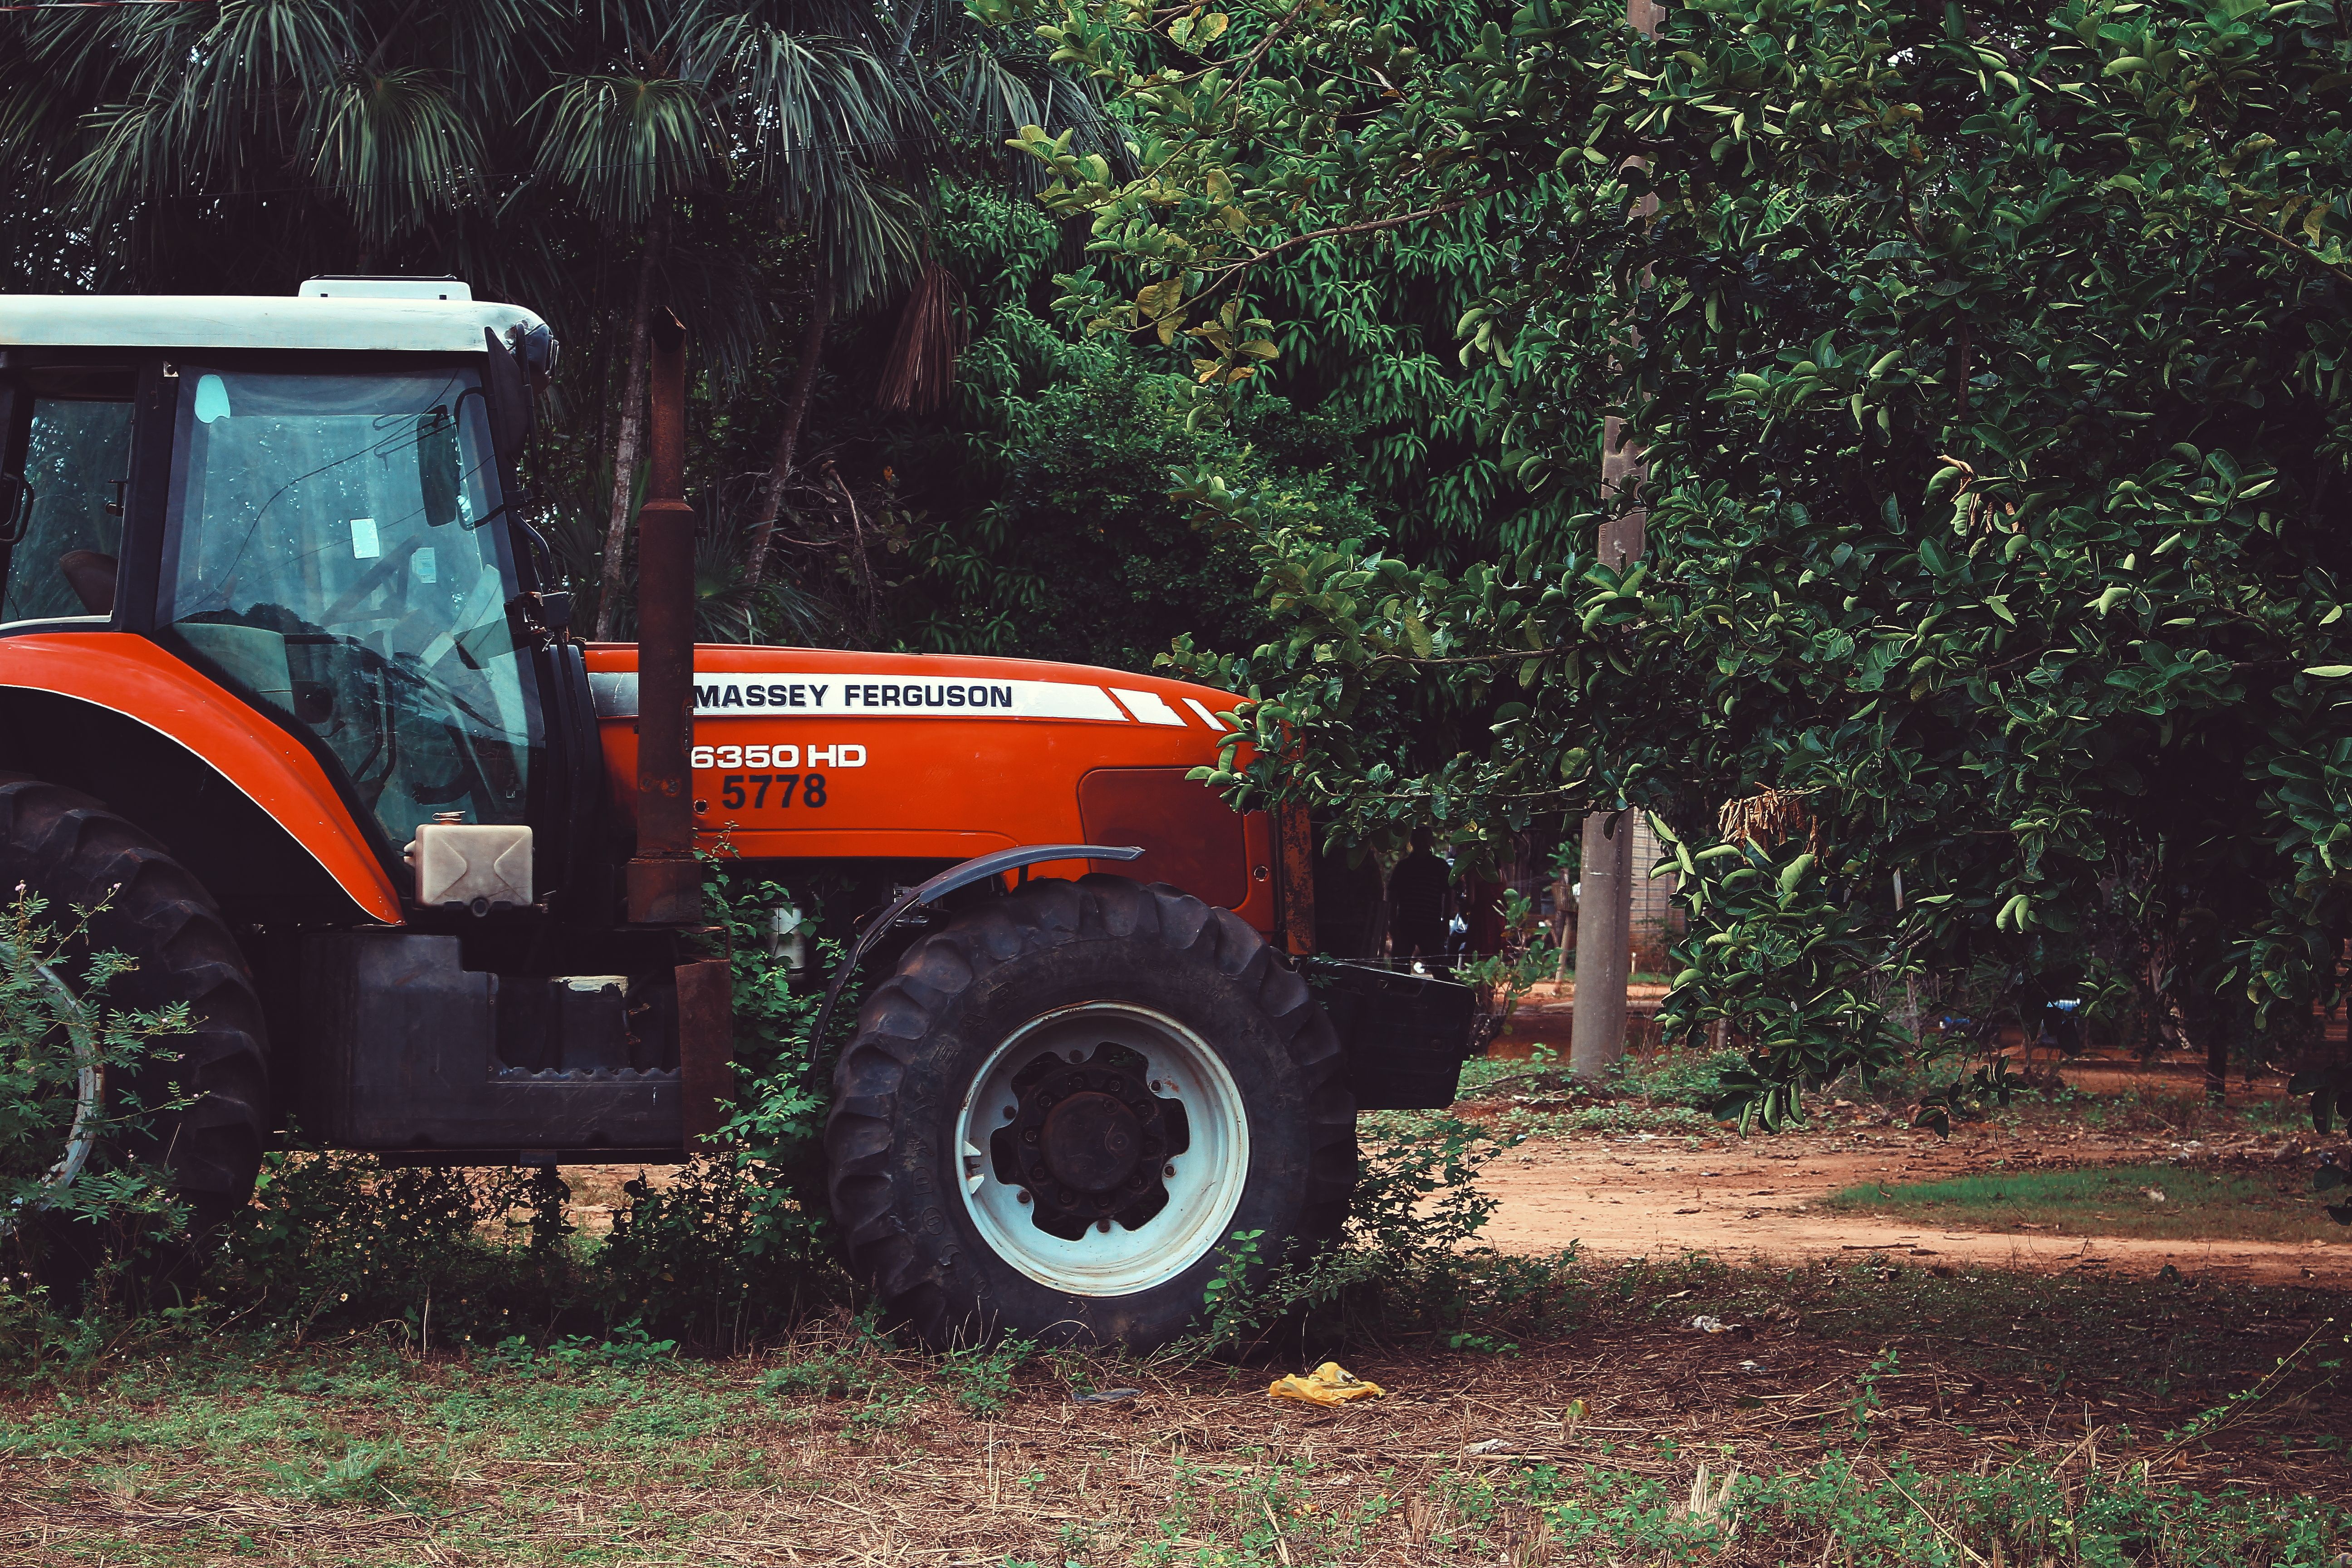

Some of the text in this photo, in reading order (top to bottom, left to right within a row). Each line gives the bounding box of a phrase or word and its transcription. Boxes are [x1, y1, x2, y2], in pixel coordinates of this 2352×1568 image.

[693, 684, 1013, 708] MASSEY FERGUSON
[691, 744, 867, 769] 6350 HD
[722, 773, 827, 809] 5778
